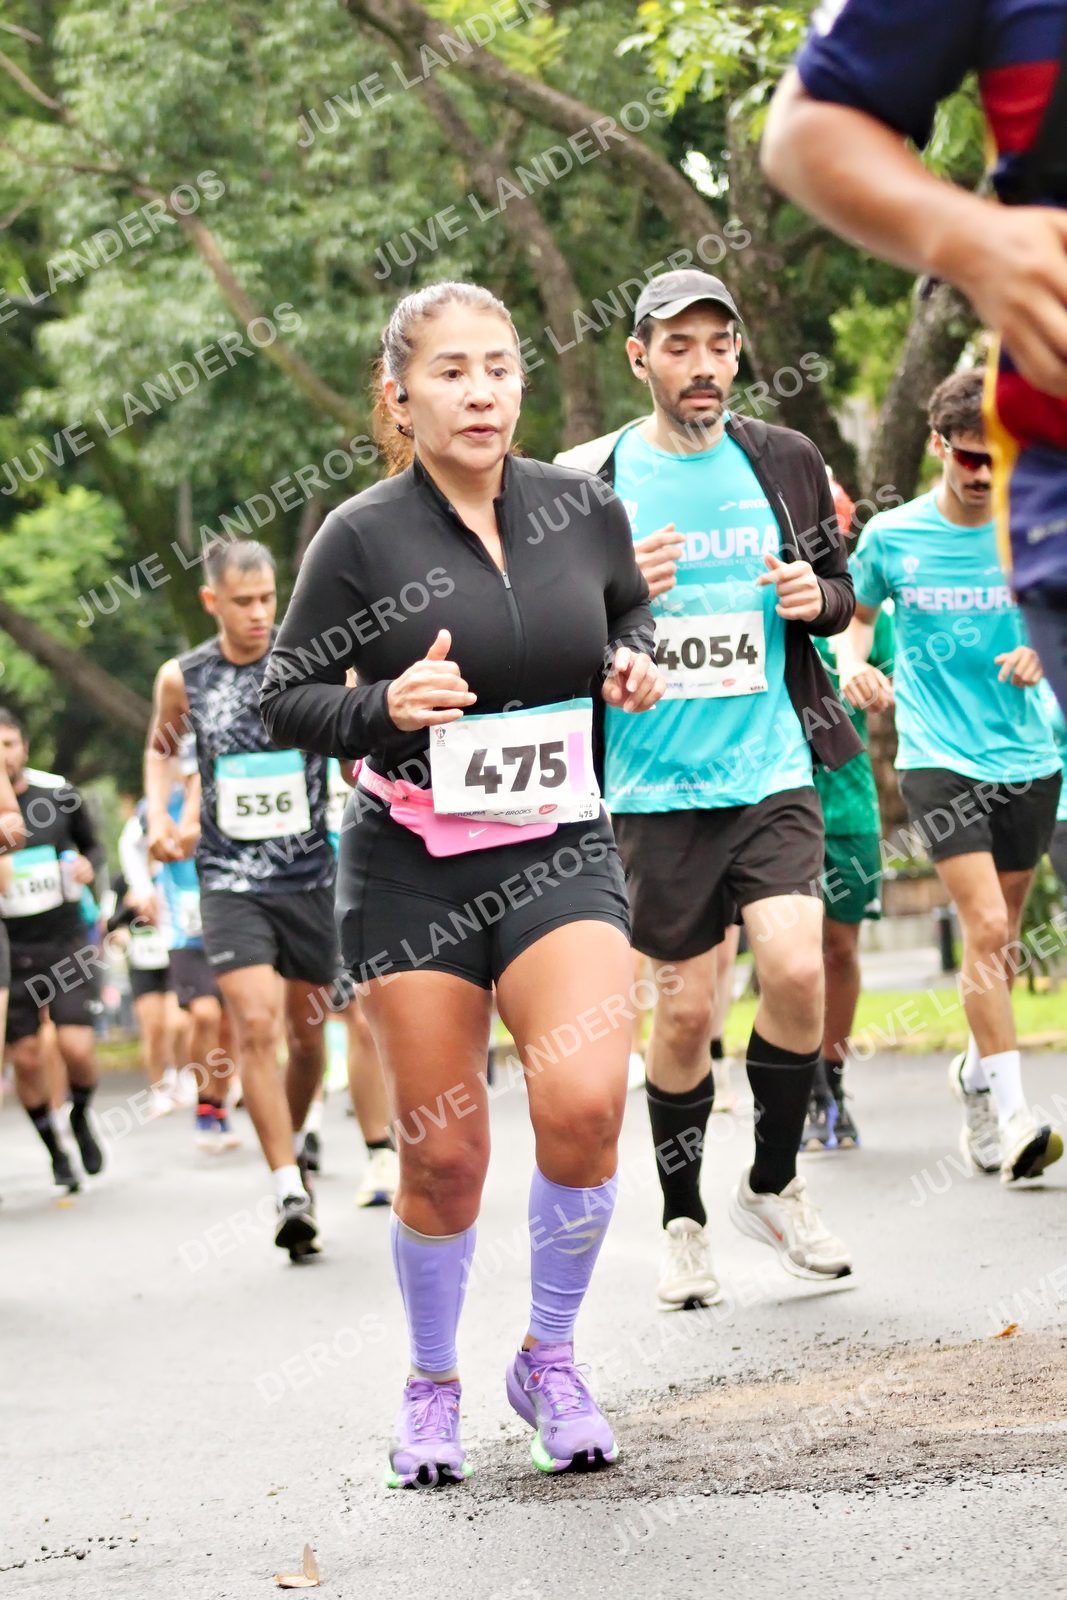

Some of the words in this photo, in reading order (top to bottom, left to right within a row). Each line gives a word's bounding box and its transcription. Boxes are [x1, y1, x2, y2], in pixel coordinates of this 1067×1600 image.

[902, 584, 1018, 612] PERDUR
[655, 633, 758, 670] 4054
[465, 741, 567, 794] 475
[236, 791, 293, 817] 536
[505, 808, 532, 816] BROOKS
[579, 810, 593, 818] 475
